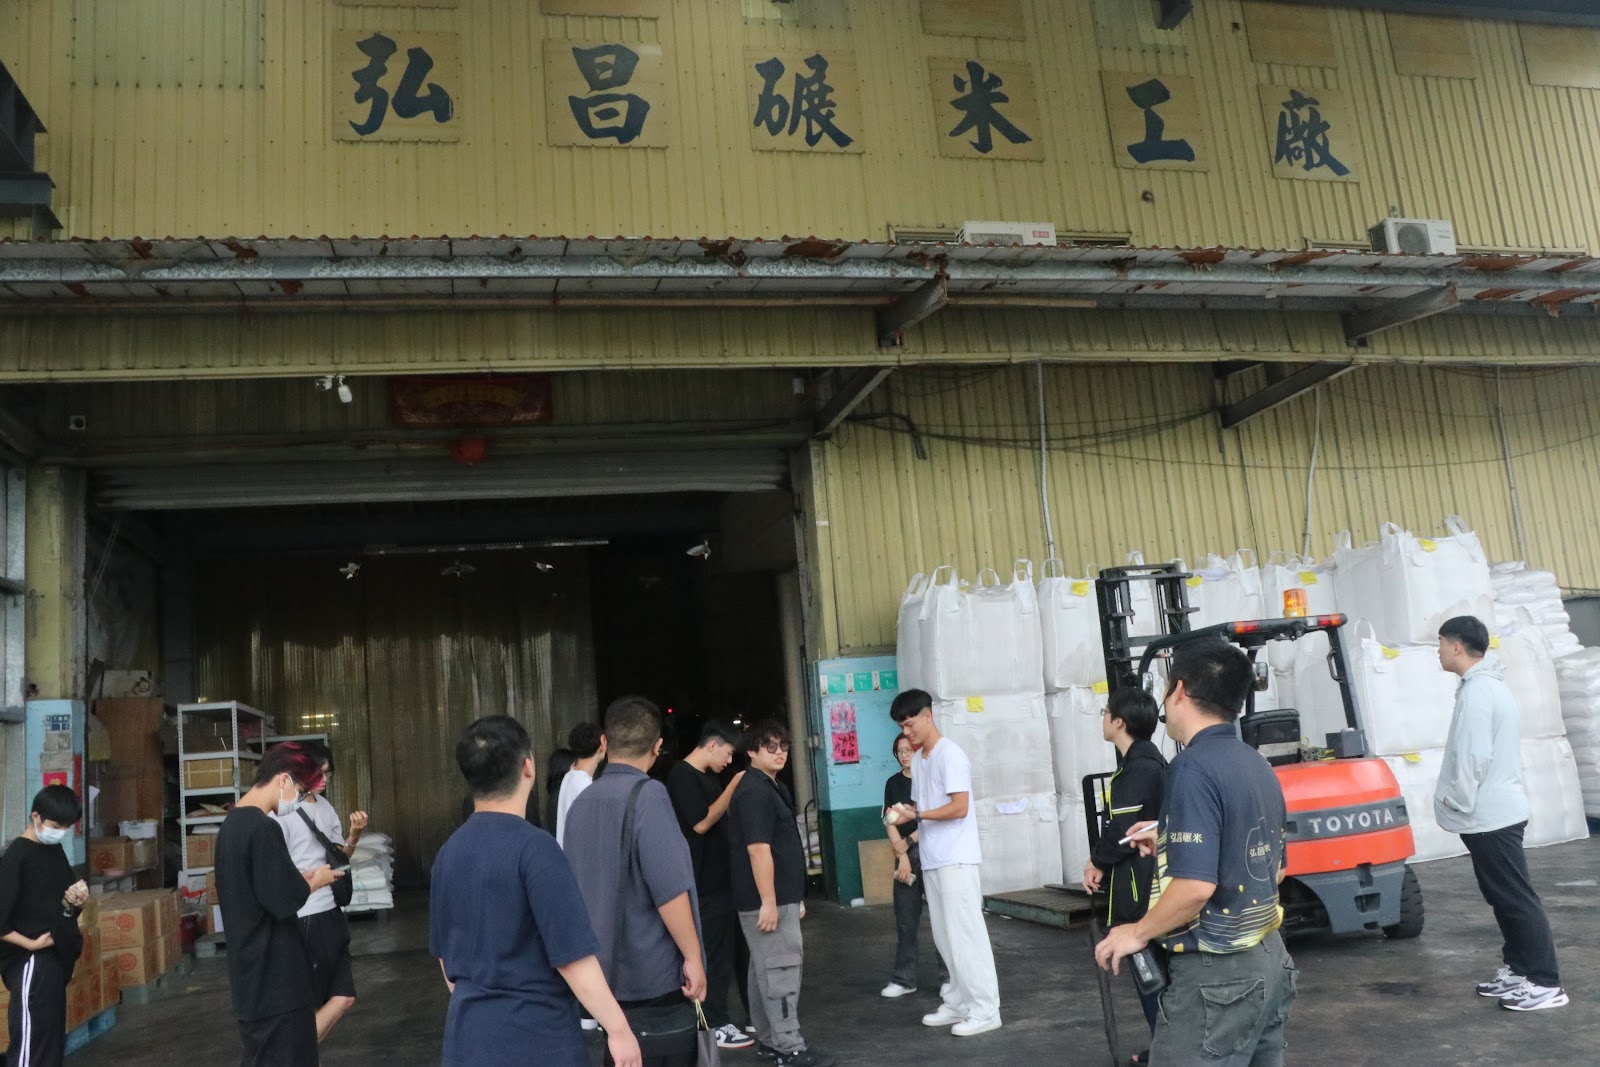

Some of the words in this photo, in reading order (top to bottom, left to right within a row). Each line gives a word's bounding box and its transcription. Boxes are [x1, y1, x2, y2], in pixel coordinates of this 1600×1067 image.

[348, 33, 1350, 176] 弘昌碾米工廠
[1308, 807, 1394, 834] TOYOTA
